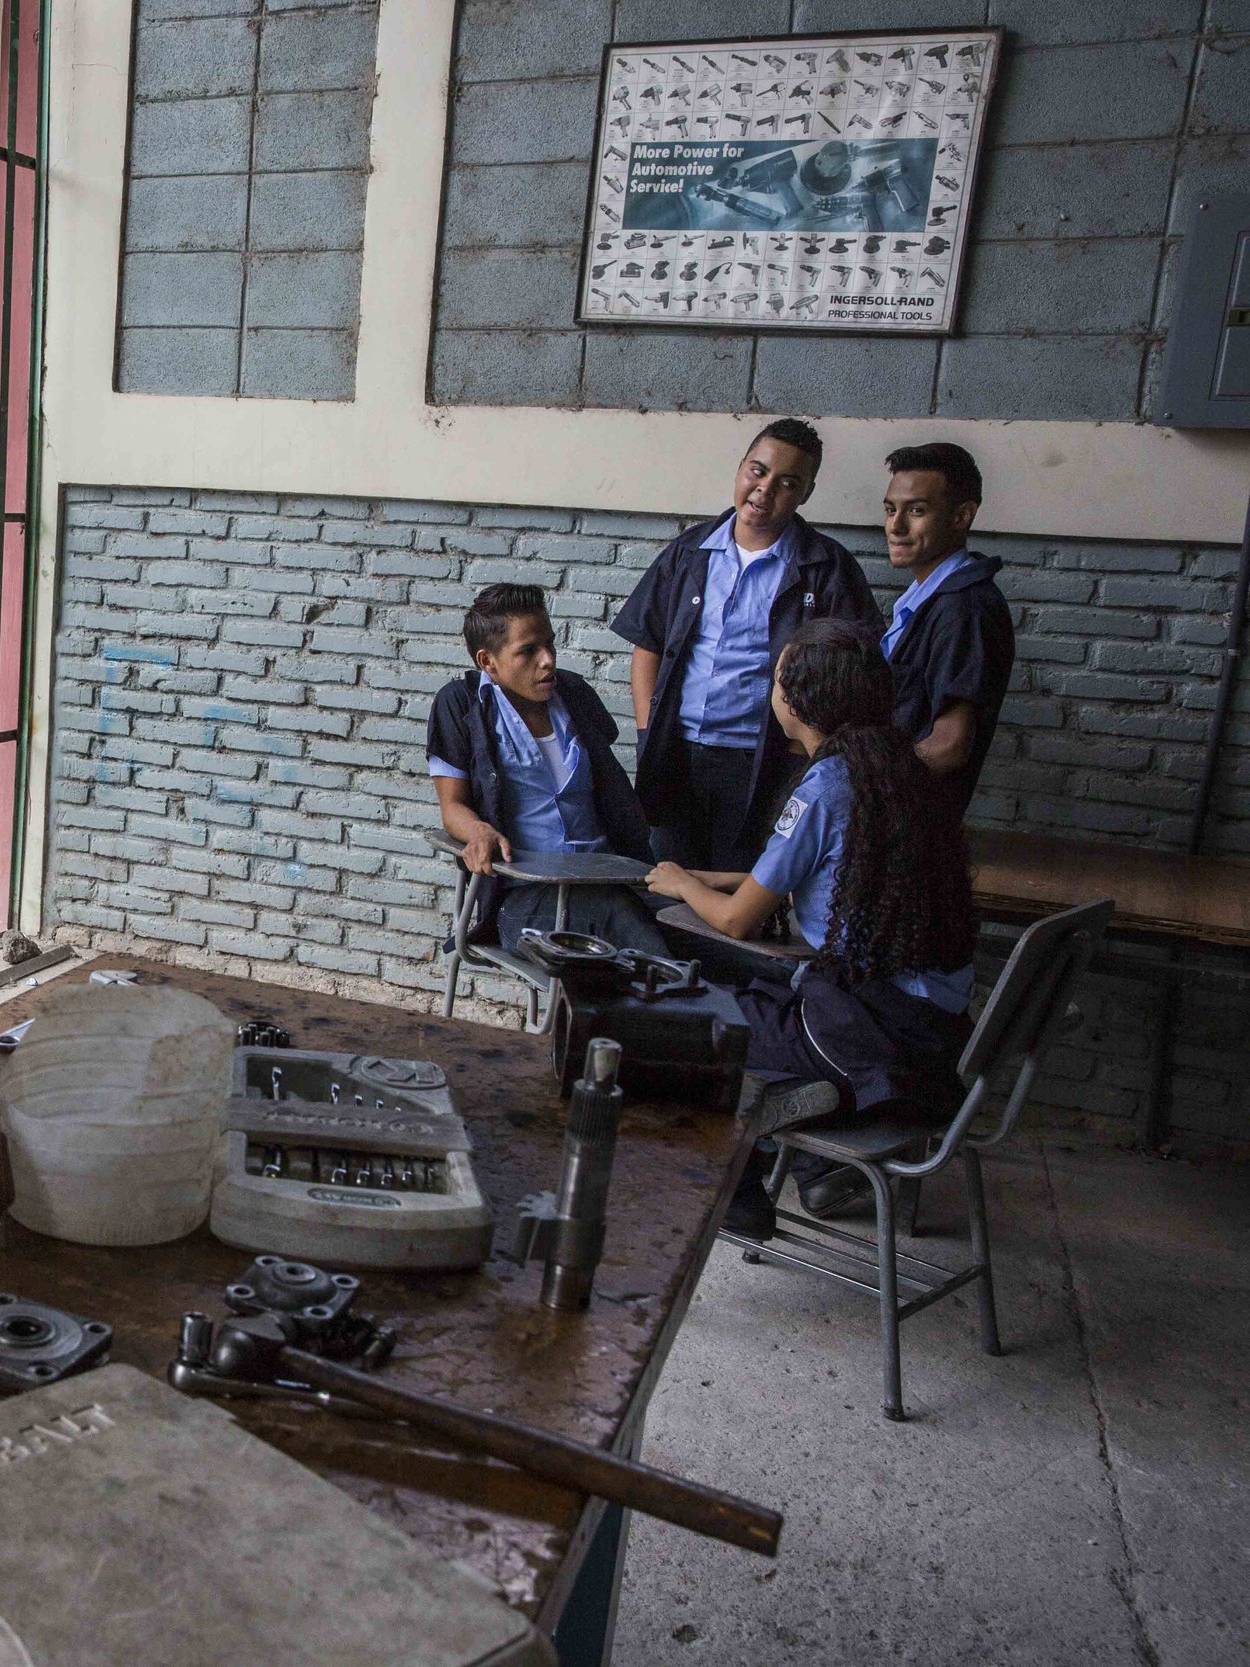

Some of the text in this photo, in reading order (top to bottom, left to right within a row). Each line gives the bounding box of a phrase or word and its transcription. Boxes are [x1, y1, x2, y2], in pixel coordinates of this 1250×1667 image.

[633, 143, 745, 158] More Power for
[631, 161, 714, 176] Automotive
[630, 178, 684, 193] Service!
[830, 295, 935, 307] INGERSOLL-RAND
[828, 310, 933, 321] PROFESSIONAL TOOLS
